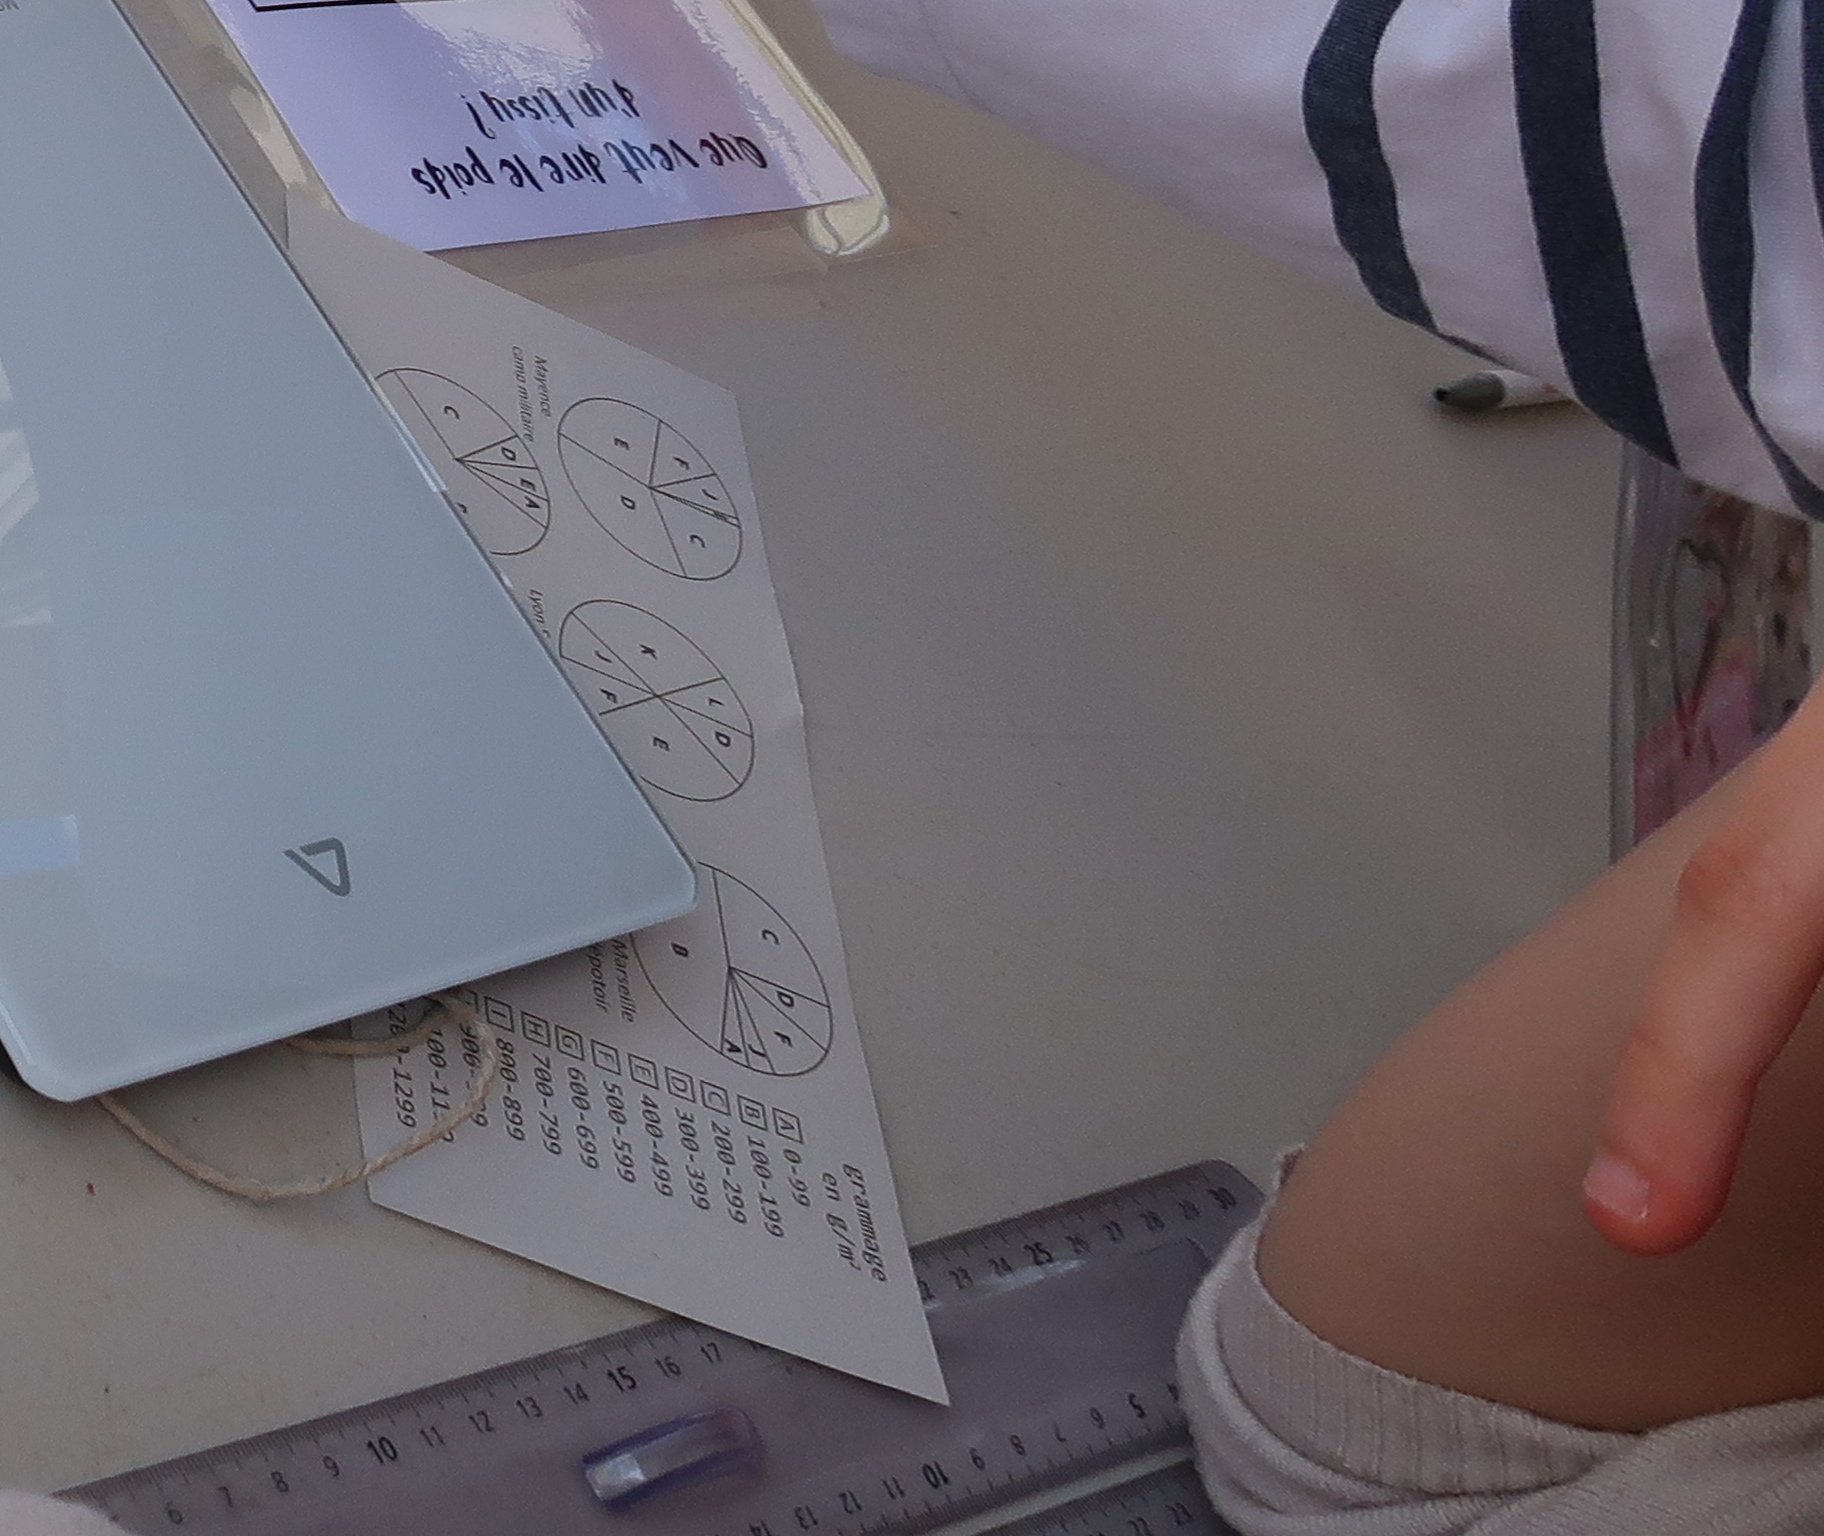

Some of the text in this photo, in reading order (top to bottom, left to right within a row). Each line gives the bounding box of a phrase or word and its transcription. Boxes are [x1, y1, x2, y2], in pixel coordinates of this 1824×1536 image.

[568, 78, 640, 118] d'un
[411, 131, 768, 200] Que veut dire le poids
[511, 344, 534, 443] camp militaire
[533, 354, 552, 418] Mayence
[443, 403, 460, 421] C
[500, 446, 517, 462] D
[613, 436, 630, 452] E
[672, 455, 690, 471] F
[519, 477, 537, 492] E
[524, 496, 541, 511] A
[619, 494, 636, 511] D
[688, 533, 706, 550] C
[528, 587, 544, 625] Lyon
[639, 643, 658, 661] K
[600, 688, 619, 704] F
[707, 696, 725, 707] L
[653, 736, 671, 753] E
[714, 731, 732, 747] D
[761, 928, 780, 946] C
[585, 941, 609, 1015] épotoir
[611, 938, 635, 1023] Marseille
[776, 989, 795, 1008] D
[724, 1037, 743, 1054] A
[773, 1030, 793, 1048] F
[495, 1037, 526, 1142] 800-899
[527, 1021, 563, 1156] H 700-799
[563, 1034, 599, 1171] G 600-699
[602, 1080, 637, 1184] 500-599
[635, 1063, 674, 1199] E 400-499
[671, 1076, 712, 1212] D 300-399
[707, 1090, 748, 1226] C 200-299
[778, 1117, 812, 1208] A 0-99
[743, 1105, 785, 1239] B 100-199
[822, 1171, 842, 1202] en
[843, 1162, 888, 1283] grammage
[270, 1469, 290, 1494] 8
[322, 1454, 341, 1480] 9
[366, 1434, 399, 1466] 10
[418, 1424, 447, 1449] 11
[467, 1408, 496, 1434] 12
[515, 1395, 543, 1420] 13
[563, 1382, 590, 1407] 14
[607, 1366, 637, 1393] 15
[655, 1354, 682, 1380] 16
[699, 1340, 722, 1365] 17
[1022, 1240, 1054, 1266] 25
[1089, 1405, 1106, 1430] 6
[1127, 1391, 1147, 1419] 5
[969, 1446, 987, 1472] 9
[1009, 1433, 1028, 1458] 8
[881, 1475, 906, 1501] 11
[920, 1459, 950, 1490] 10
[837, 1487, 863, 1516] 12
[793, 1504, 819, 1530] 13
